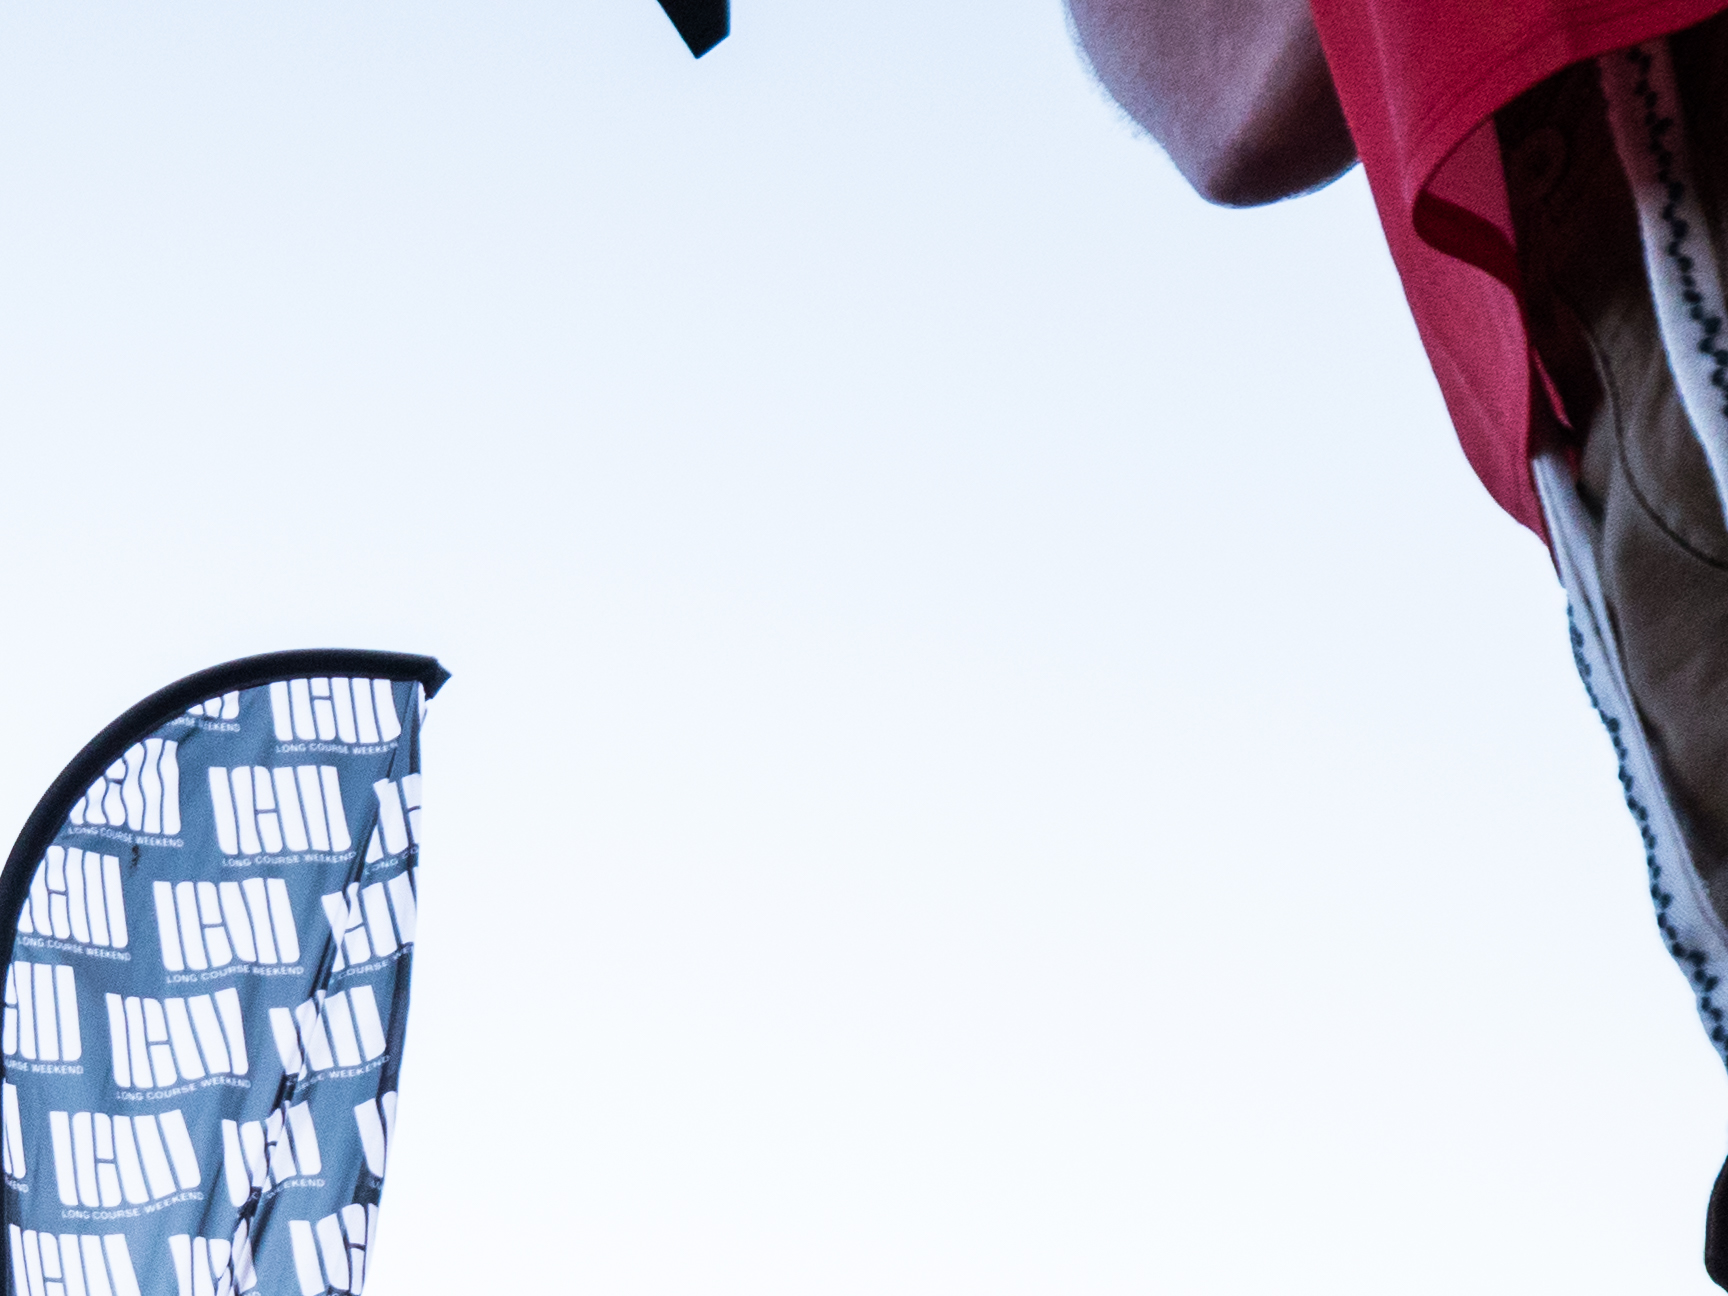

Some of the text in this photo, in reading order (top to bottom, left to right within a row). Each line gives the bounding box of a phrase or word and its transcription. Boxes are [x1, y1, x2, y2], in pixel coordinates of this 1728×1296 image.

[276, 743, 306, 753] LONG
[310, 743, 348, 754] COURSE
[222, 851, 356, 867] LONG COURSE WEEKEND
[167, 971, 198, 983] LONG
[201, 964, 250, 981] COURSE
[32, 1063, 83, 1075] WEEKEND
[148, 1083, 196, 1100] COURSE
[61, 1191, 204, 1220] LONG COURSE WEEKEND
